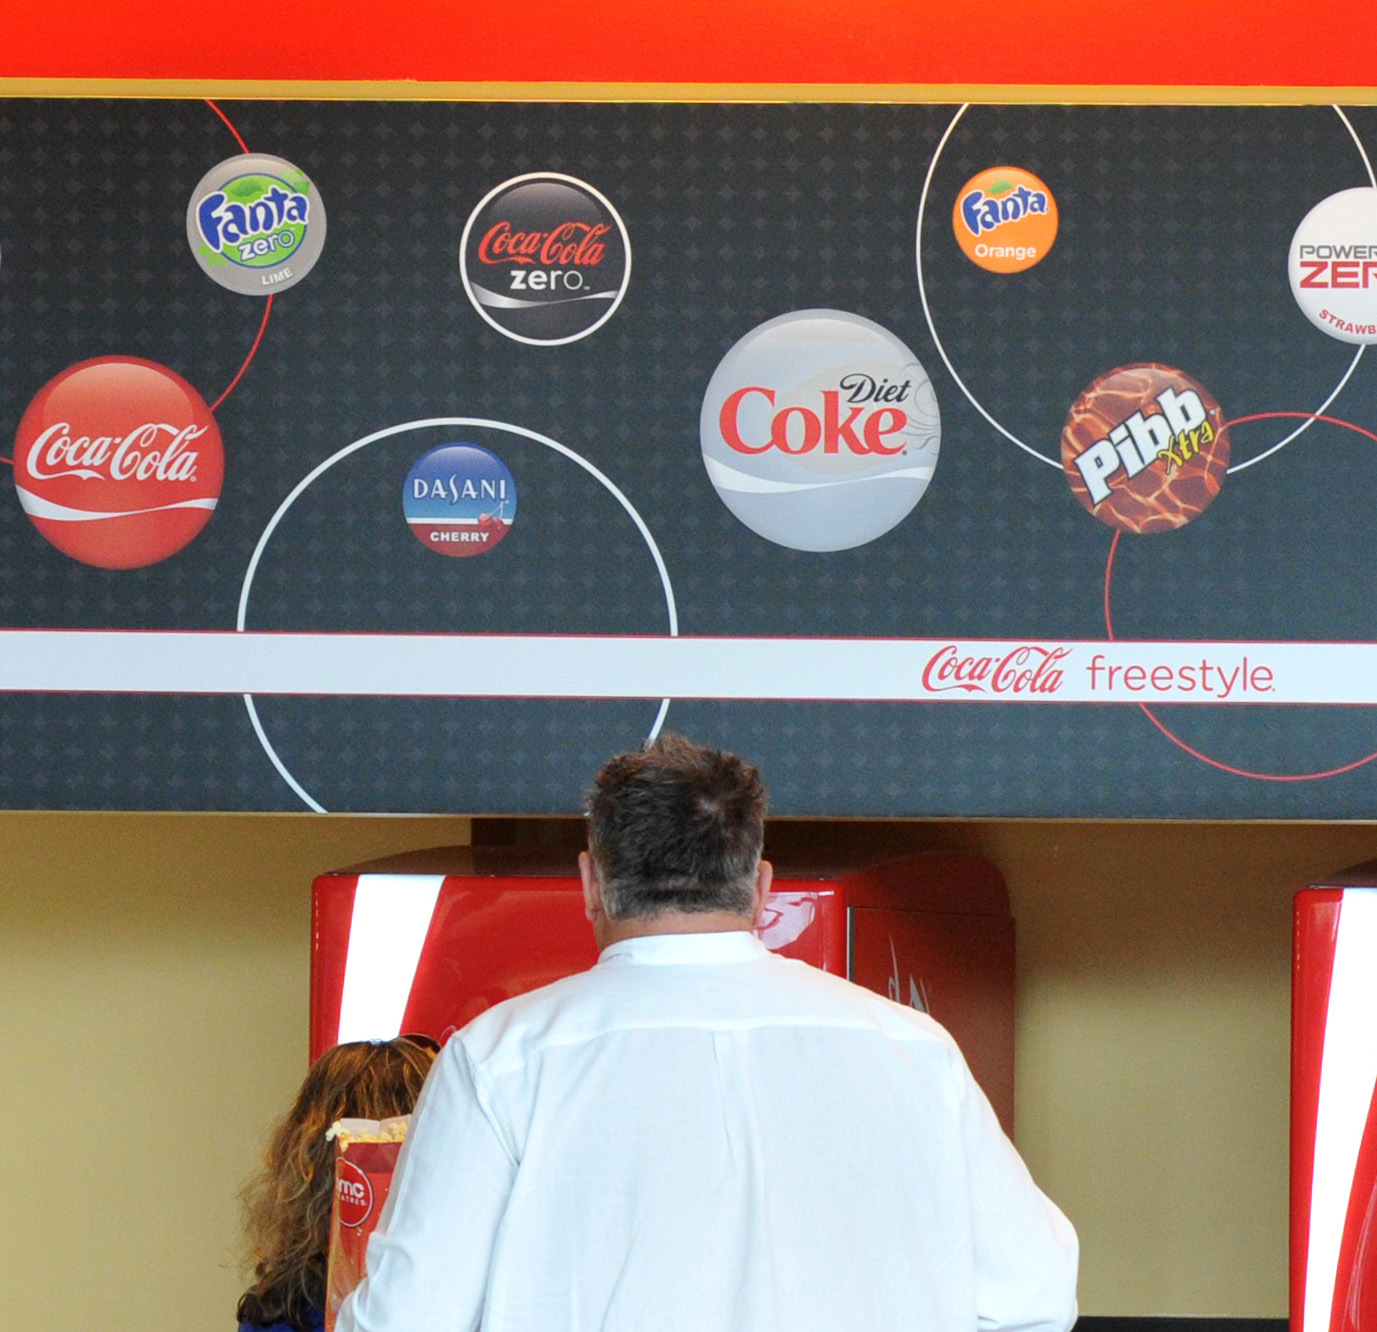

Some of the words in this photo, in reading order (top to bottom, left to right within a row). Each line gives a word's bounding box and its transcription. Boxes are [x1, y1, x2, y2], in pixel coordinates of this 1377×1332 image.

[198, 186, 309, 245] Fanta
[962, 186, 1048, 236] Fanta
[239, 227, 295, 261] zero
[478, 221, 611, 267] Coca-Cola
[975, 244, 1037, 262] Orange
[261, 267, 294, 286] LIME
[510, 268, 583, 290] zero
[840, 373, 910, 404] Diet
[719, 387, 907, 456] Coke
[27, 422, 208, 483] Coca-Cola
[1072, 383, 1209, 506] Pibb
[1157, 419, 1216, 477] Xtra
[413, 476, 507, 504] DASANI
[430, 531, 490, 543] CHERRY
[921, 645, 1073, 695] Coca-Cola
[1087, 653, 1276, 699] freestyle
[337, 1178, 365, 1199] mc
